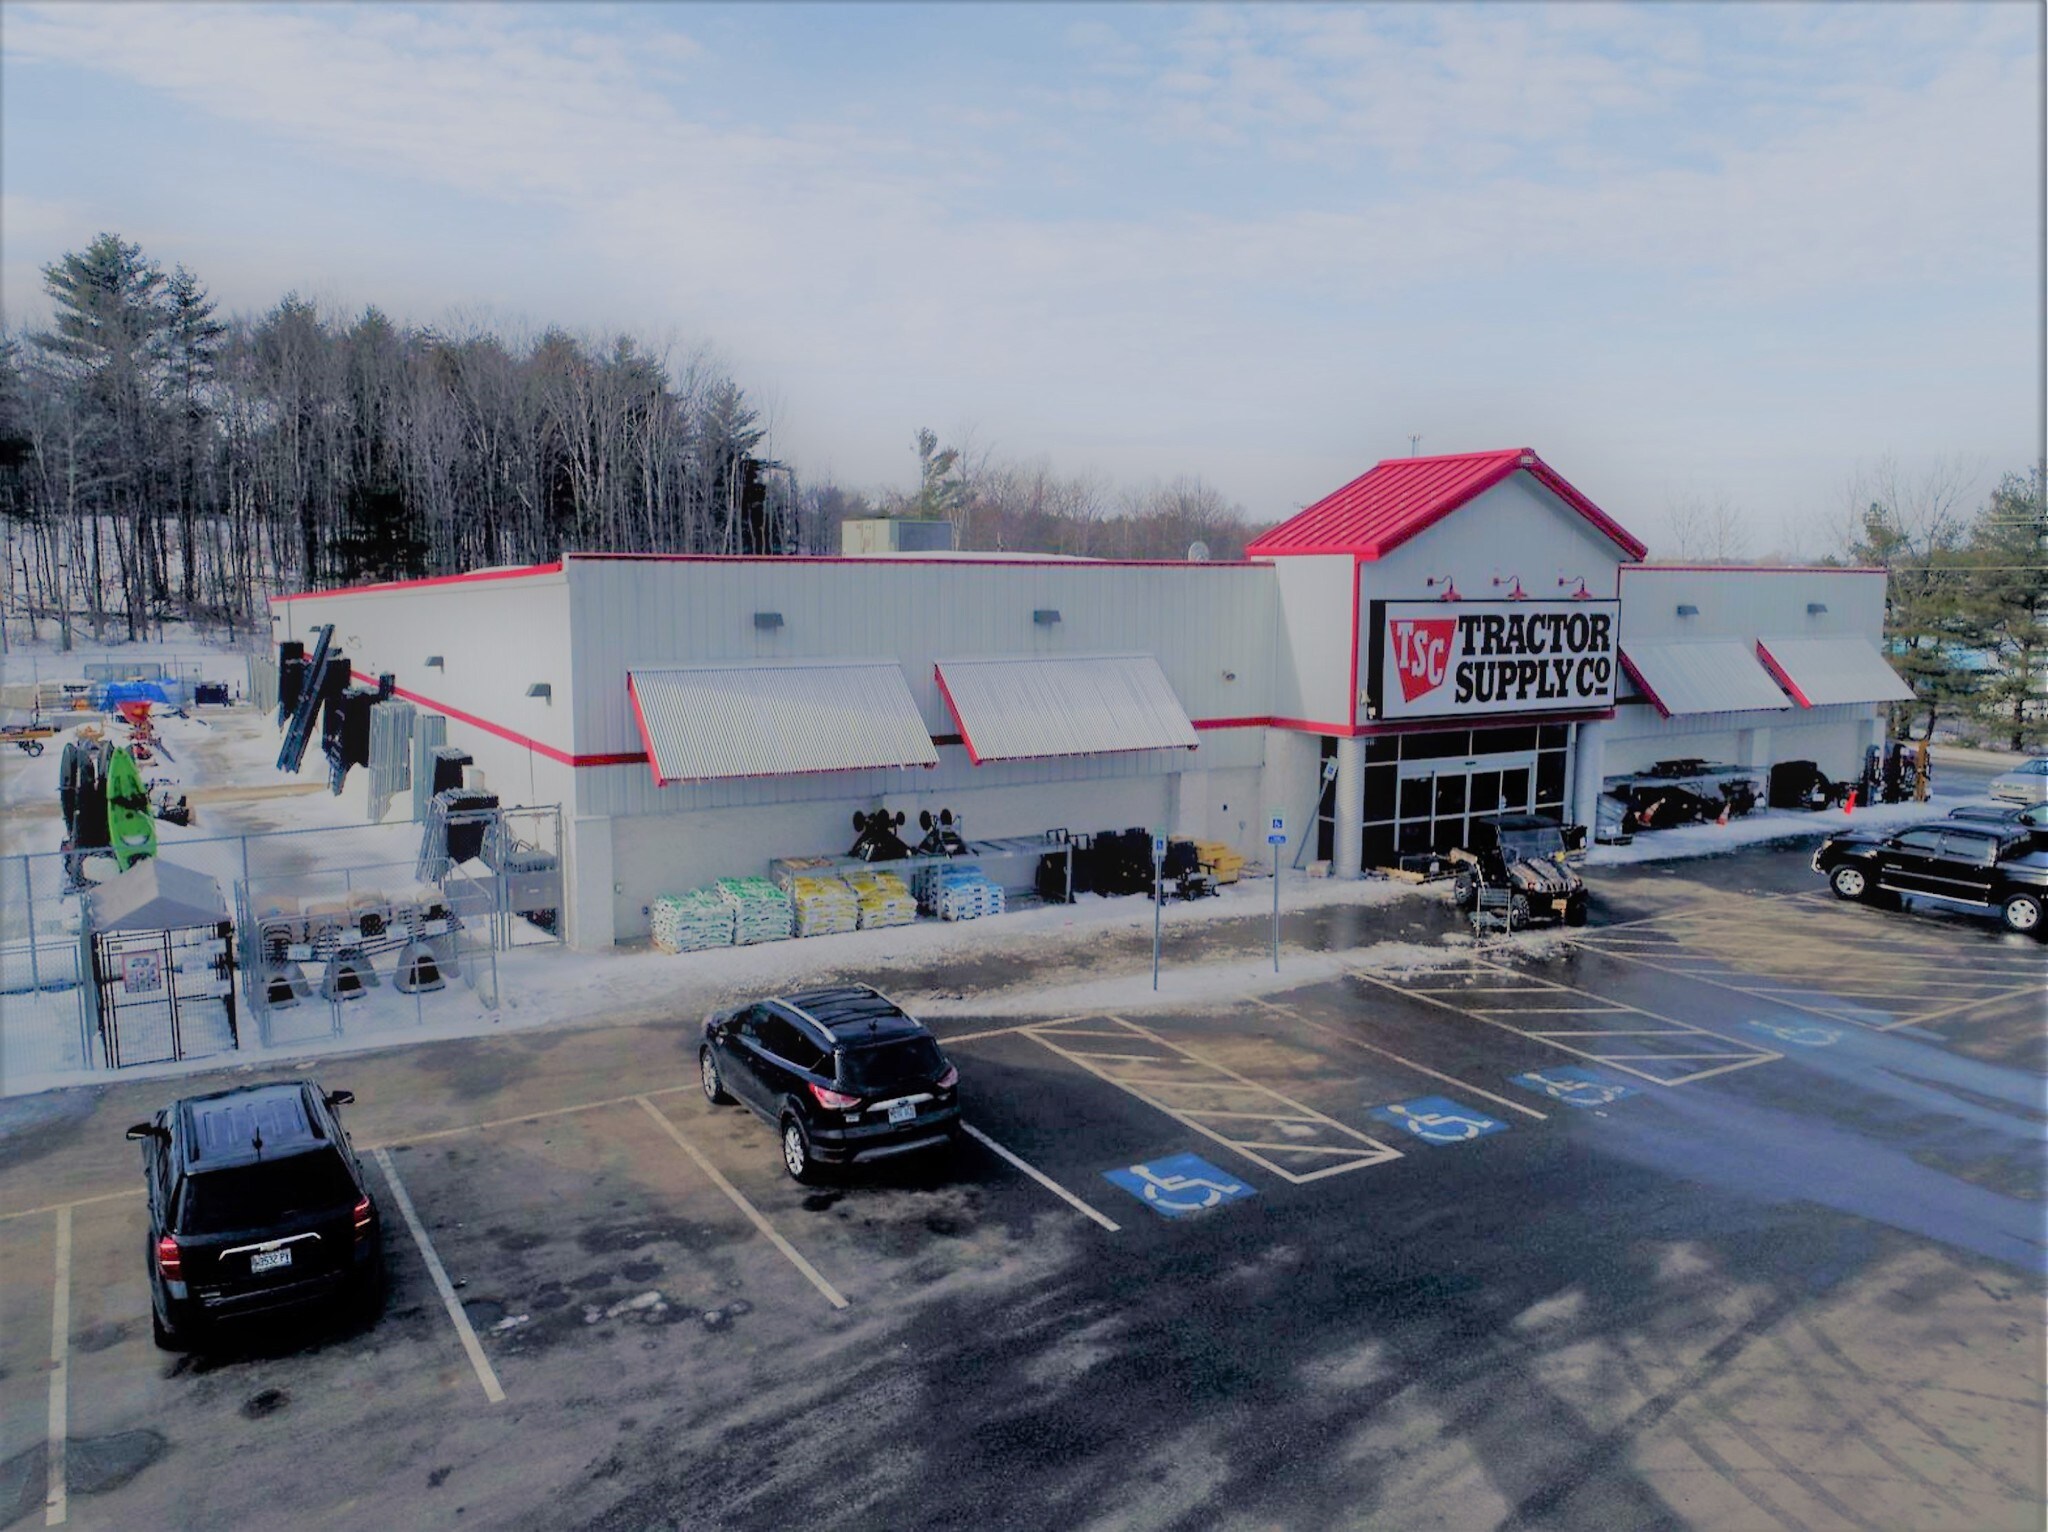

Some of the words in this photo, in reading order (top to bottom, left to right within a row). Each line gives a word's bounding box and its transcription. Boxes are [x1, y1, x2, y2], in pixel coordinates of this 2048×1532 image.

[1396, 622, 1445, 687] TSC
[1458, 613, 1611, 656] TRACTOR
[1455, 659, 1574, 703] SUPPLY
